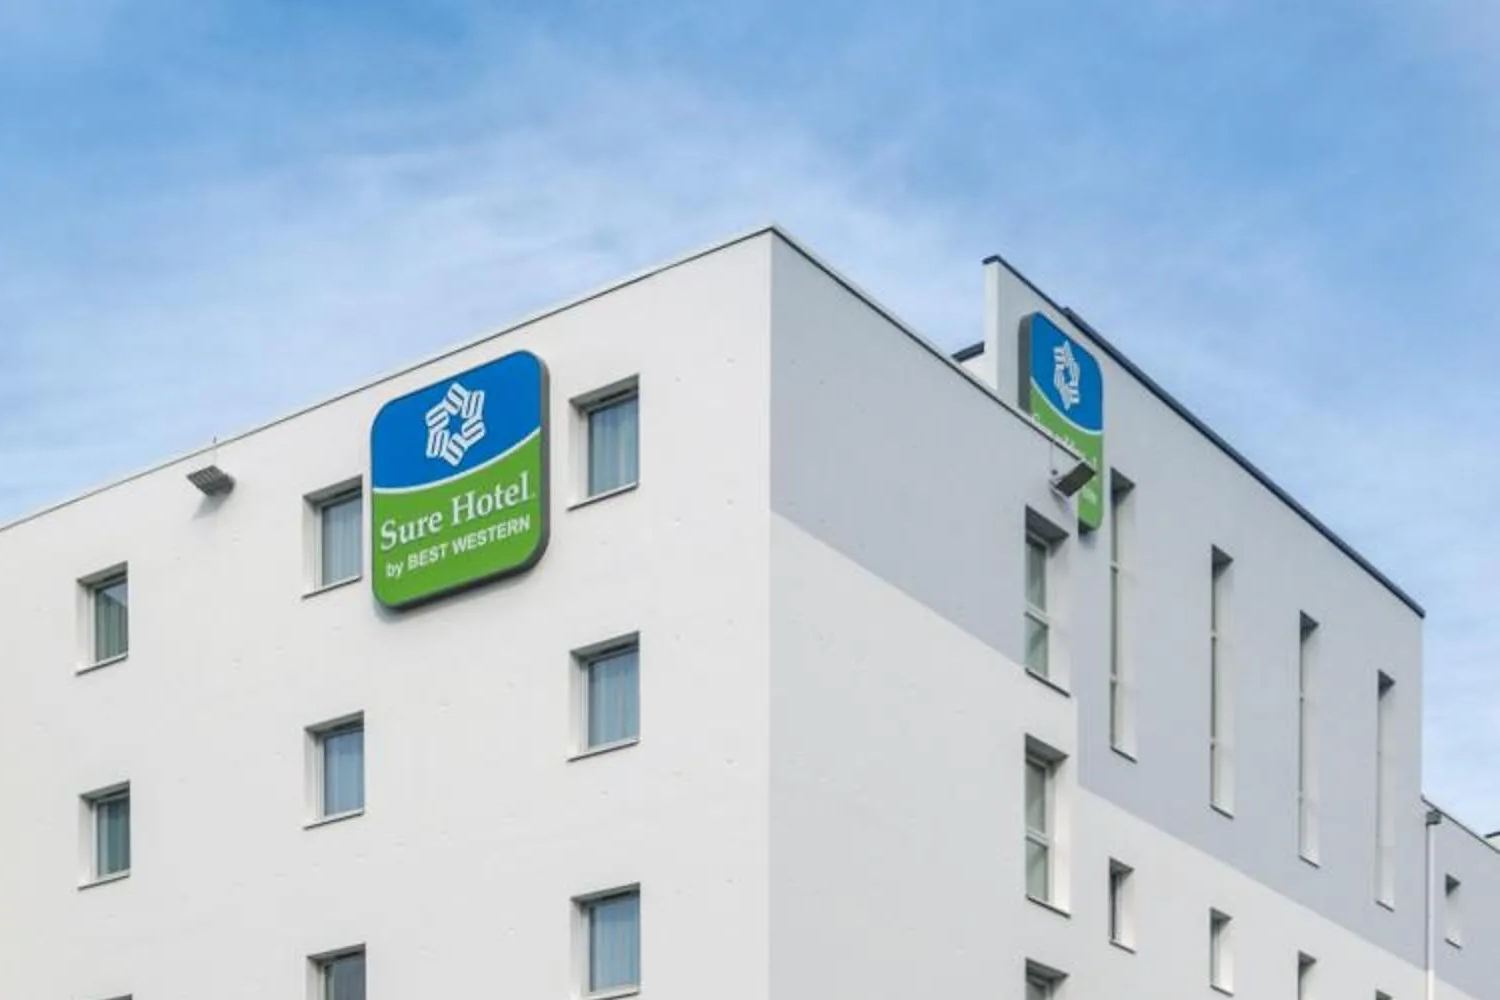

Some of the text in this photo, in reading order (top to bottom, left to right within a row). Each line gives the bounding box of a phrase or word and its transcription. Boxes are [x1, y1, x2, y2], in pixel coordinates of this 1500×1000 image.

[380, 470, 530, 550] Sure Hotel
[385, 514, 531, 578] by BEST WESTERN
